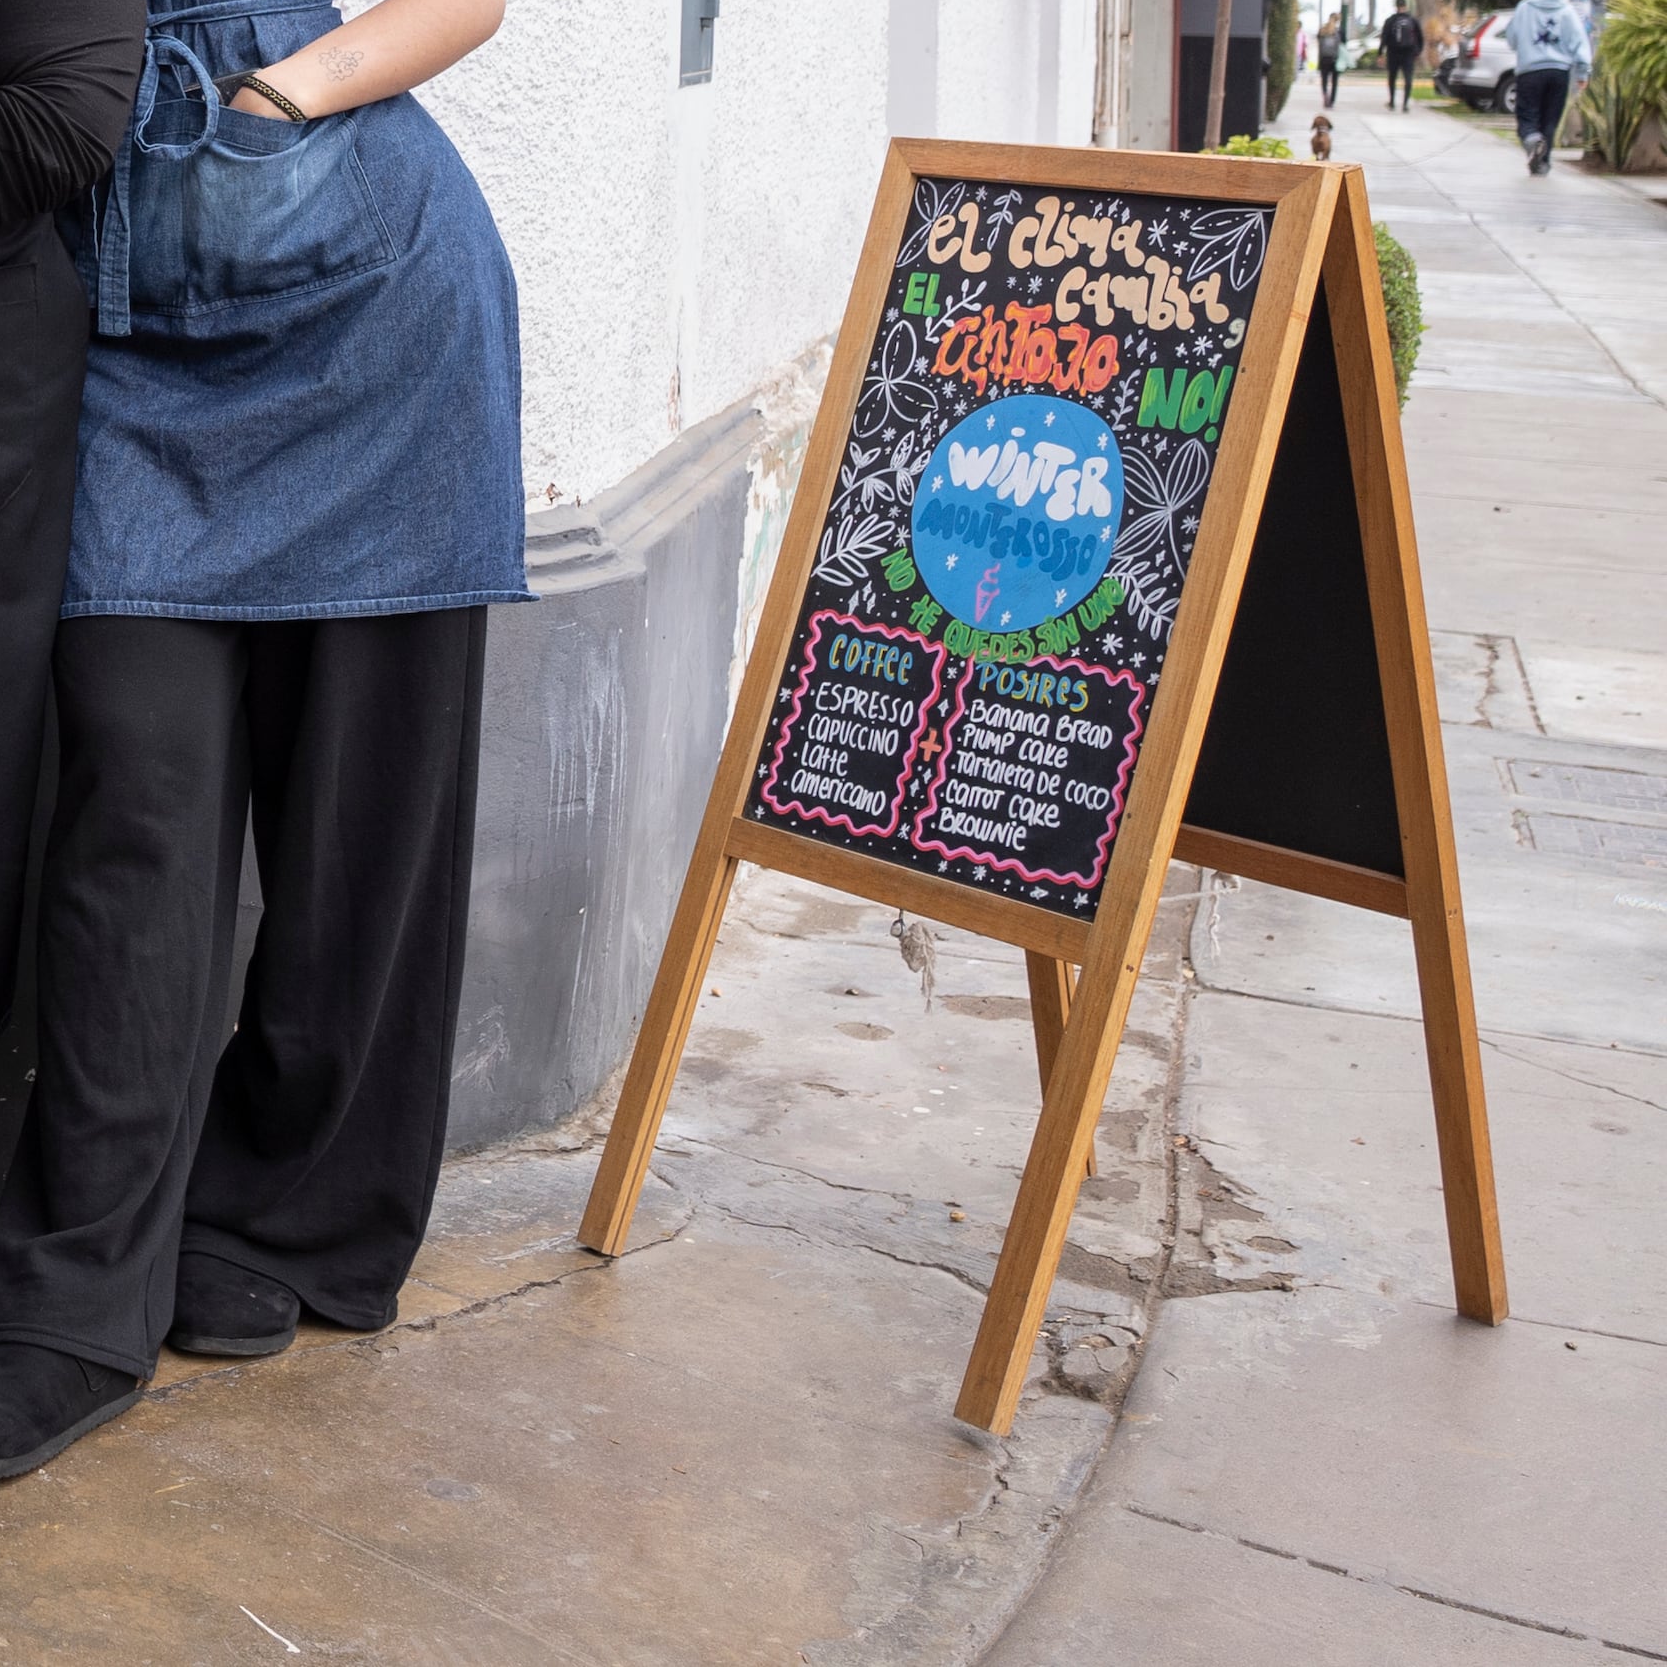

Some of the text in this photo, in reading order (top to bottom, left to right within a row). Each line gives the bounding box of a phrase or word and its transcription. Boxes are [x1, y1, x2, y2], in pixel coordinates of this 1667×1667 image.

[1008, 196, 1146, 269] clima
[902, 273, 941, 317] EL
[1136, 365, 1235, 443] NO!
[948, 427, 1112, 521] WINTER
[917, 498, 1098, 582] MONTEROSSO
[880, 547, 916, 592] NO
[943, 619, 1035, 664] QUEDES
[1077, 578, 1125, 632] UNO
[816, 682, 914, 727] ESPRESSO
